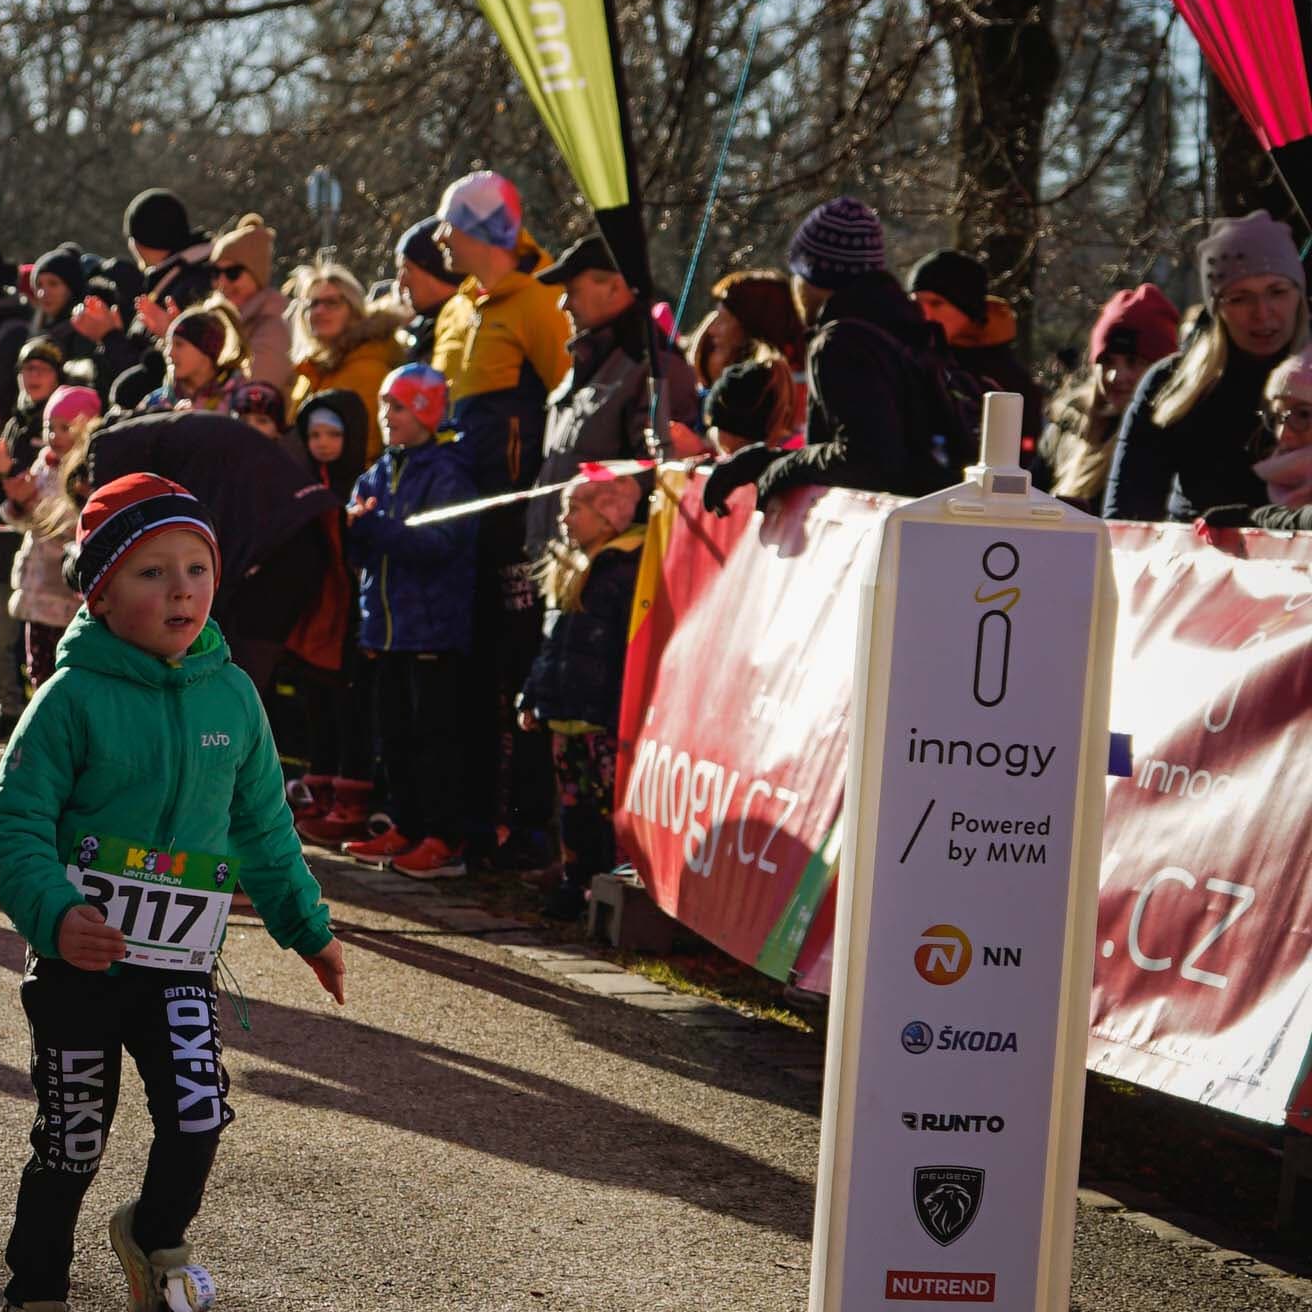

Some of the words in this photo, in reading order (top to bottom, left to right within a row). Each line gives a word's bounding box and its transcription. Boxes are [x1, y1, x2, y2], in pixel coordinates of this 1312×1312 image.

[907, 728, 1057, 777] innogy
[950, 812, 1051, 836] Powered
[948, 840, 977, 866] by
[987, 843, 1047, 864] MVM
[982, 946, 1022, 967] NN
[936, 1026, 1018, 1053] ŠKODA
[921, 1113, 1005, 1134] RUNTO
[920, 1172, 978, 1182] PEUGEOT
[892, 1278, 990, 1297] NUTREND
